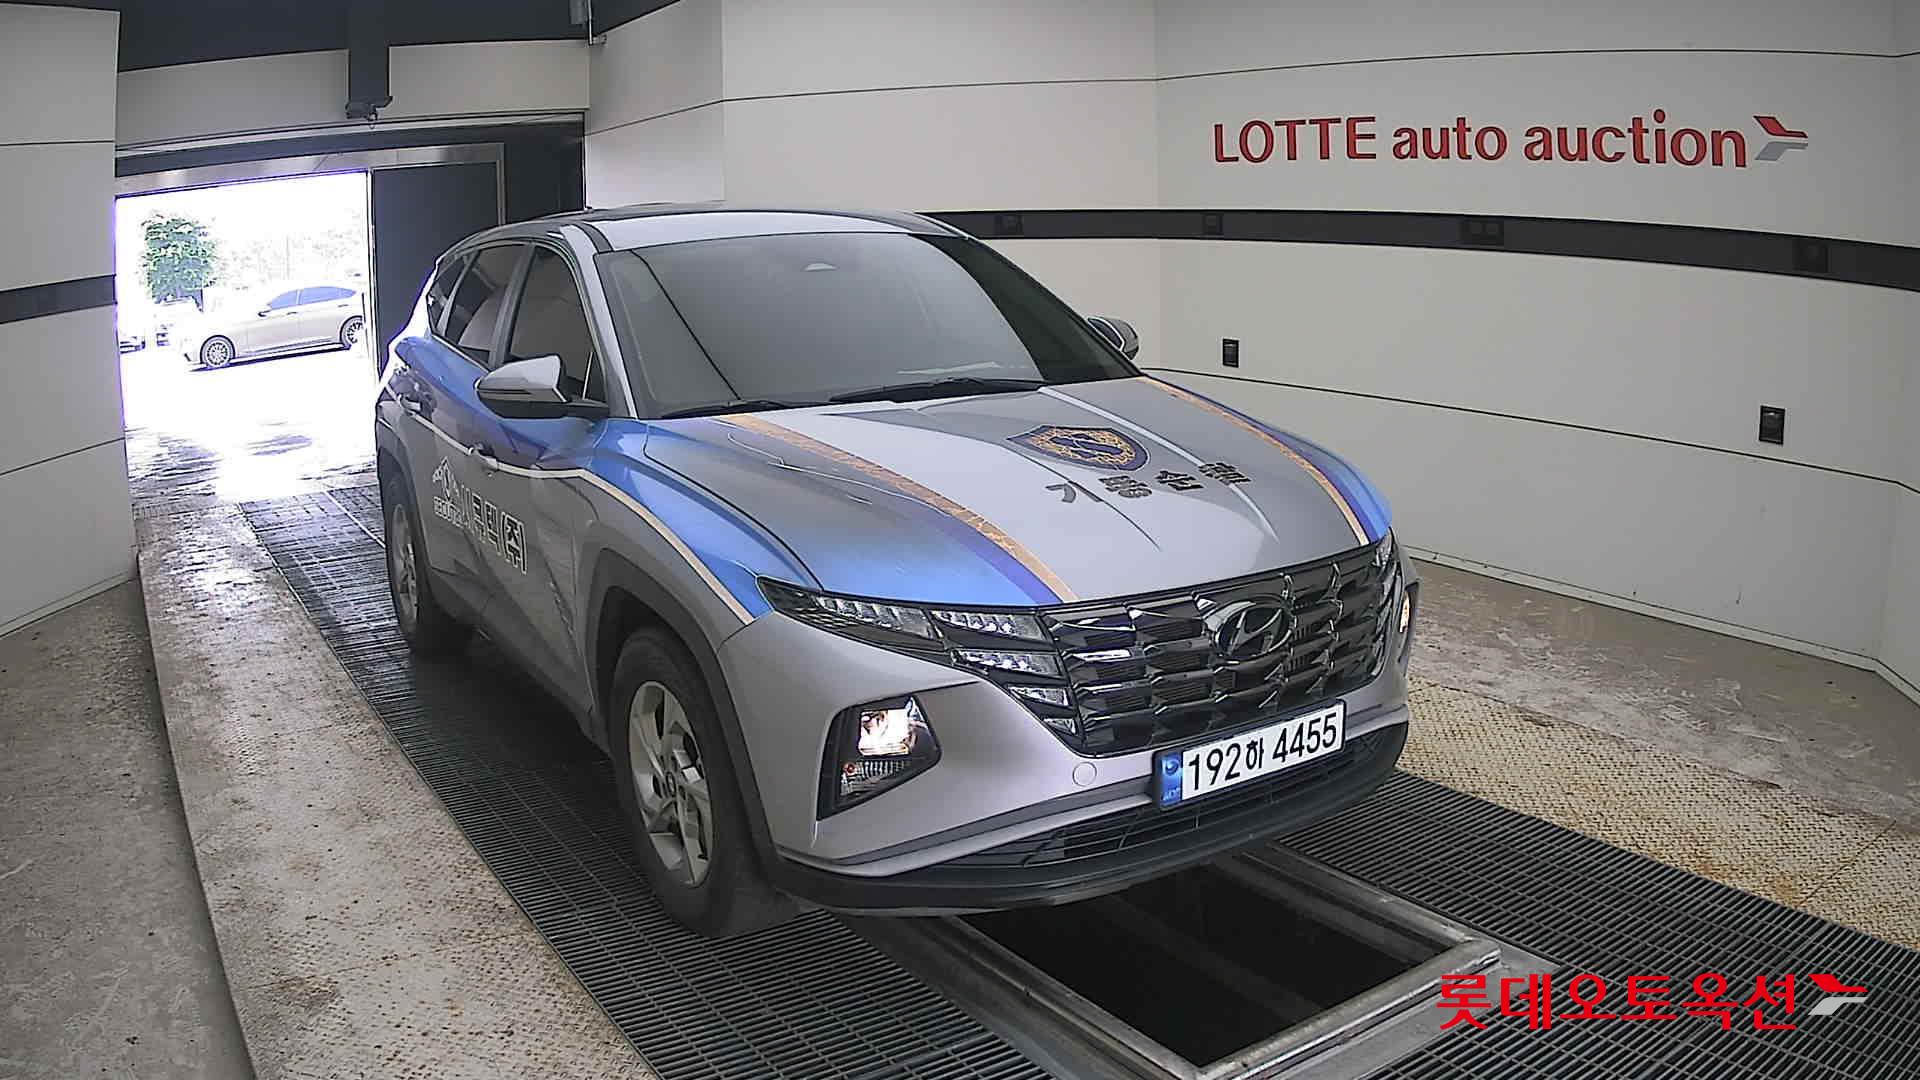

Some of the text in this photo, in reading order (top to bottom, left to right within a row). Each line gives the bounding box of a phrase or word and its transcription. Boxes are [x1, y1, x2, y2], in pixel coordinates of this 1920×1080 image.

[1213, 108, 1748, 169] LOTTE auto auction
[1188, 712, 1338, 791] 192하 4455
